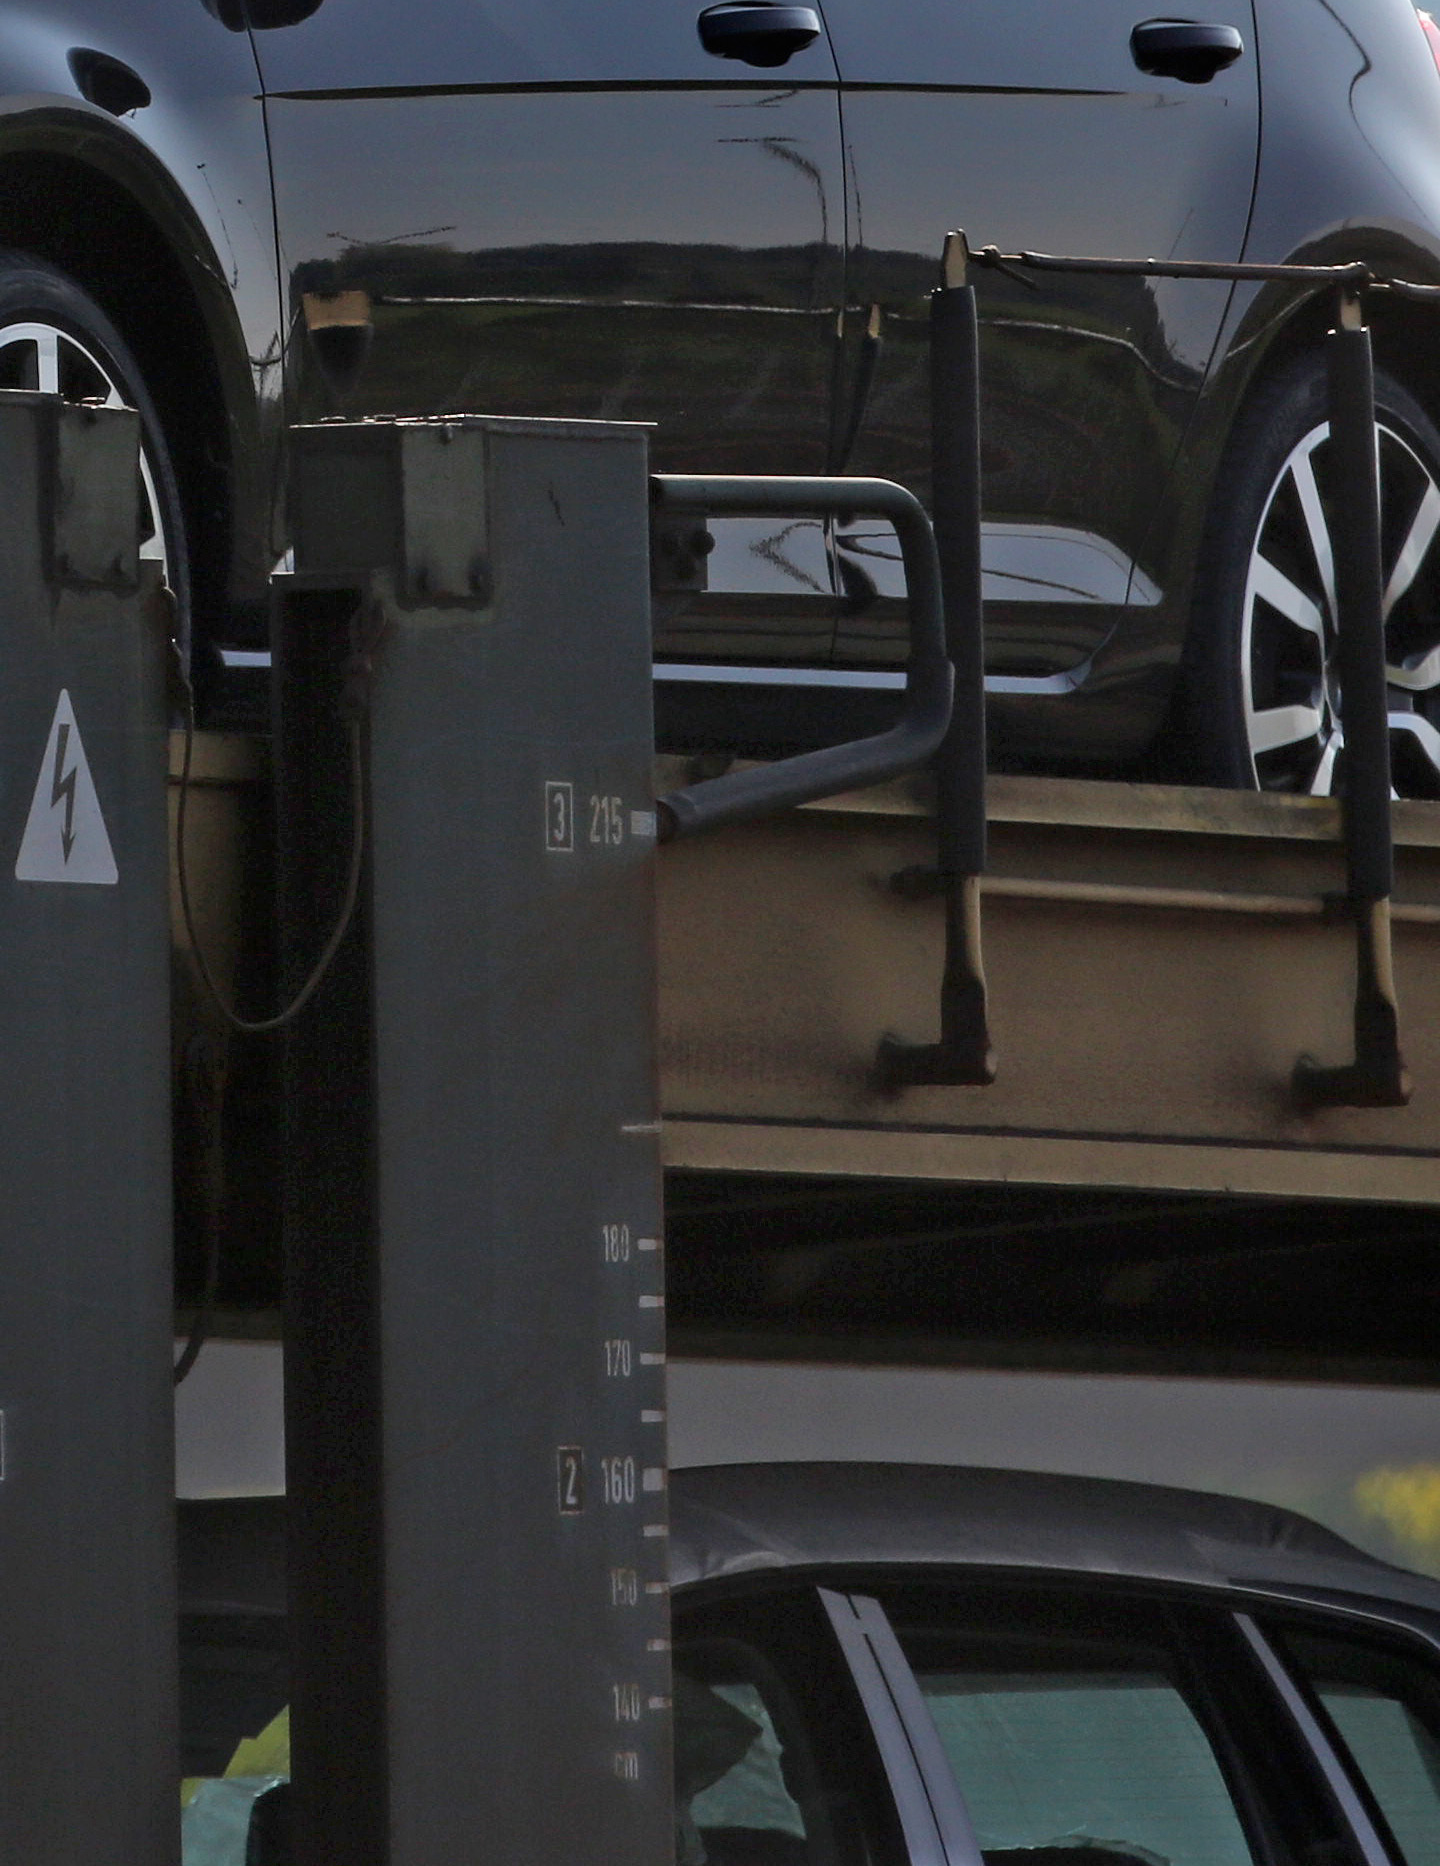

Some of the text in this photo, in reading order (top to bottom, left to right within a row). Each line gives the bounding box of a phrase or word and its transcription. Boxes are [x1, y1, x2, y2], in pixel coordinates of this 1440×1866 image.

[554, 793, 623, 845] 3 215
[603, 1224, 629, 1262] 180
[605, 1340, 631, 1377] 170
[566, 1457, 635, 1504] 2 160
